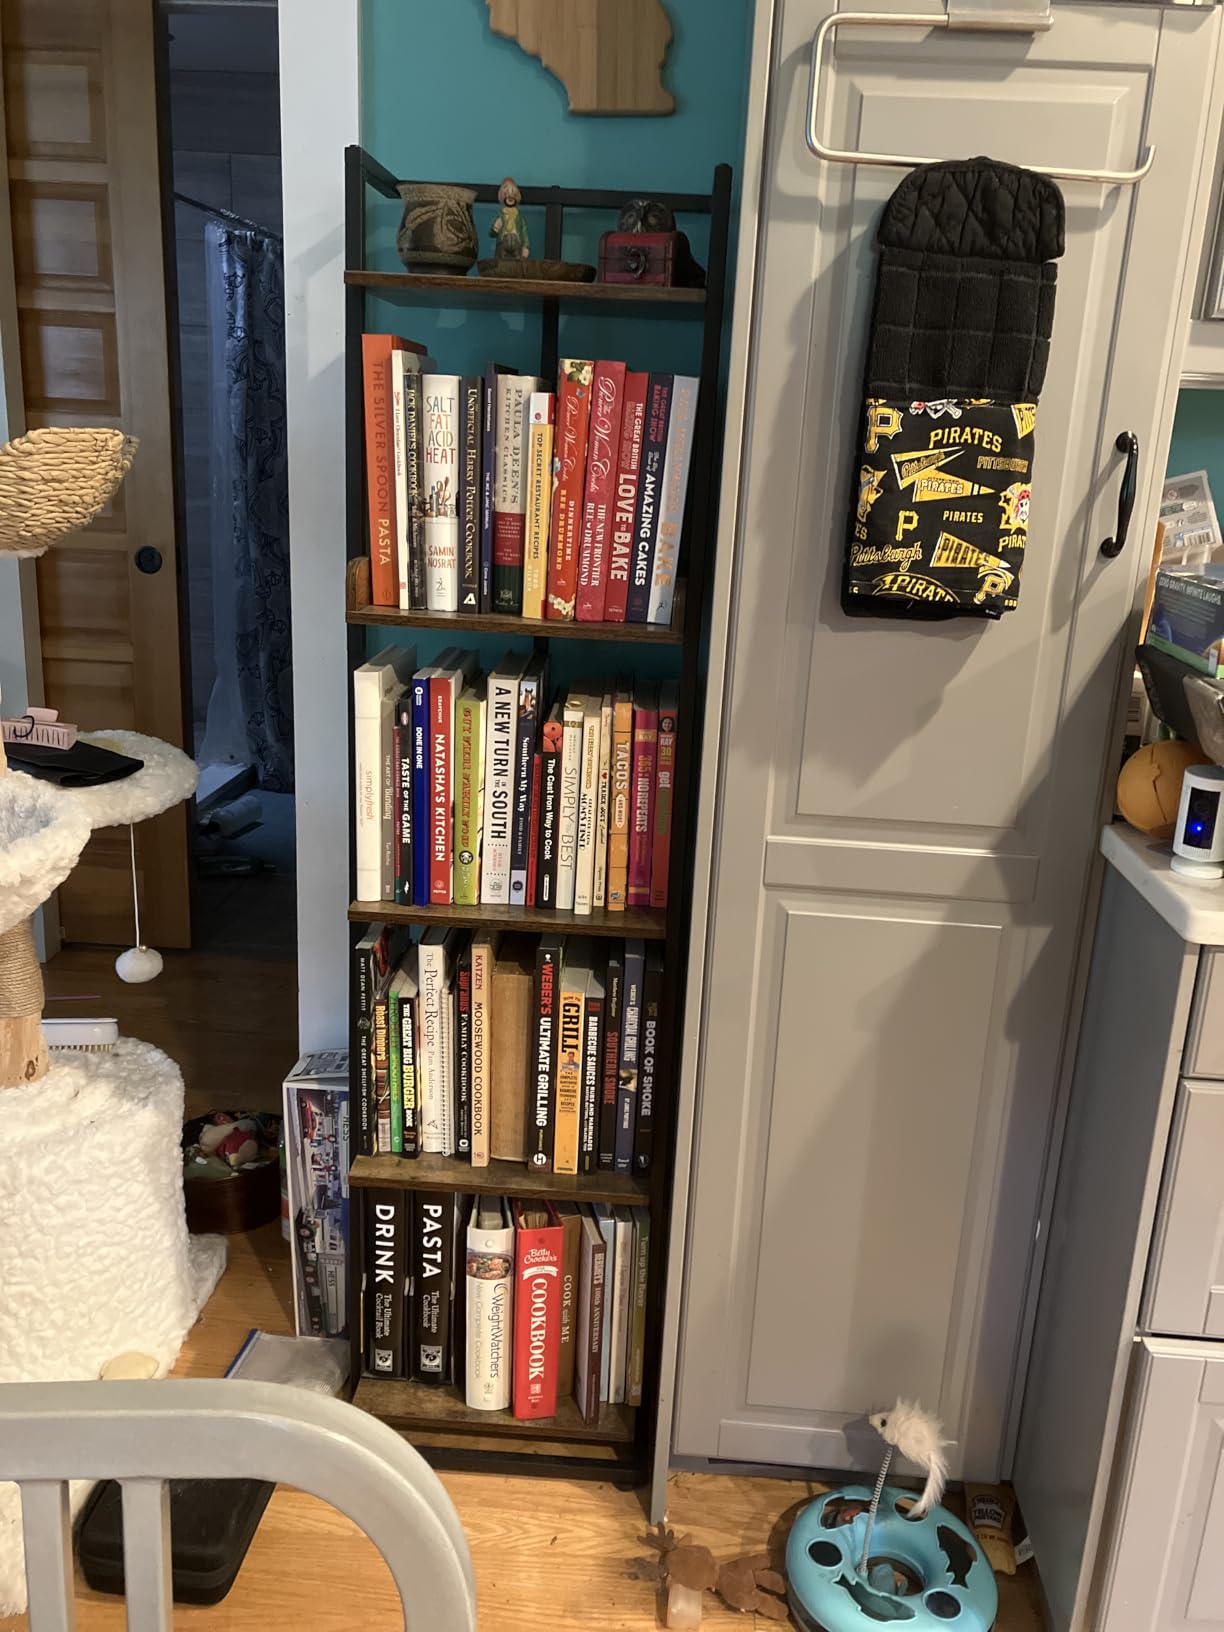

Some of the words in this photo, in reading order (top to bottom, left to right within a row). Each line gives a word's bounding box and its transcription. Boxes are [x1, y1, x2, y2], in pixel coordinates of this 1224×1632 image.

[371, 361, 385, 391] THE
[407, 389, 416, 409] JACK
[426, 396, 456, 413] SALT
[512, 388, 522, 439] PAULA
[635, 402, 644, 417] THE
[374, 397, 387, 449] SILVER
[430, 413, 451, 431] FAT
[466, 388, 478, 446] UNOFFICIAL
[503, 387, 512, 442] KITCHEN
[408, 411, 417, 449] DANIEL'S
[427, 430, 454, 447] ACID
[536, 432, 544, 447] TOP
[633, 418, 643, 442] GREAT
[928, 426, 1003, 453] PIRATES
[425, 447, 457, 465] HEAT
[465, 448, 477, 483] Harry
[535, 448, 543, 477] SECRET
[630, 443, 640, 470] BRITISH
[976, 455, 1028, 473] PITTSBURGH
[376, 454, 390, 513] SPOON
[408, 450, 418, 498] COOKBOOK
[502, 445, 510, 504] CLASSICS
[511, 446, 521, 504] DEEN'S
[919, 482, 964, 495] PIRATES
[465, 486, 477, 521] Potter
[534, 479, 542, 528] RESTAURANT
[559, 488, 567, 509] REE
[586, 502, 596, 522] REE
[597, 503, 606, 521] THE
[615, 473, 637, 524] LOVE
[640, 473, 657, 538] AMAZING
[565, 500, 576, 561] DINNERTIME
[596, 522, 605, 541] NEW
[895, 511, 919, 541] P
[942, 510, 984, 524] PIRATES
[378, 519, 391, 566] PASTA
[428, 545, 455, 557] SAMIN
[464, 523, 476, 579] COOKBOOK
[533, 531, 541, 560] RECIPES
[555, 512, 566, 571] DRUMMOND
[654, 521, 678, 587] BAKE
[850, 541, 923, 572] Pittsburgh
[938, 538, 991, 567] PIRATES
[428, 557, 456, 569] NOSRAT
[580, 529, 593, 585] DRUMMOND
[590, 543, 603, 587] FRONTIER
[610, 532, 632, 582] BAKE
[634, 541, 649, 587] CAKES
[495, 686, 512, 697] A
[493, 701, 511, 734] NEW
[415, 726, 423, 746] DONE
[415, 746, 423, 755] IN
[401, 757, 410, 787] TASTE
[415, 754, 423, 769] ONE
[434, 733, 446, 803] NATASHA'S
[493, 738, 510, 777] TURN
[520, 736, 530, 778] Southern
[547, 758, 556, 774] The
[615, 742, 630, 789] TACOS
[403, 789, 410, 799] OF
[518, 779, 528, 793] My
[546, 774, 555, 793] Cast
[658, 771, 672, 788] get
[517, 794, 527, 812] Way
[546, 794, 554, 810] Iron
[562, 767, 578, 823] SIMPLY
[401, 813, 411, 844] GAME
[490, 790, 508, 840] SOUTH
[544, 811, 554, 828] Way
[434, 807, 446, 862] KITCHEN
[545, 829, 552, 838] to
[544, 838, 553, 860] Cook
[559, 834, 574, 871] BEST
[426, 952, 434, 967] The
[475, 954, 483, 991] KATZEN
[424, 969, 439, 1007] Perfect
[458, 971, 470, 1012] Sopranos
[540, 963, 554, 1015] WEBER'S
[375, 1005, 387, 1028] Roast
[403, 1003, 411, 1017] THE
[624, 1006, 639, 1035] CHARCOAL
[402, 1017, 413, 1048] GREAT
[423, 1009, 439, 1047] Recipe
[460, 1013, 469, 1049] FAMILY
[474, 1001, 483, 1074] MOOSEWOOD
[561, 1002, 581, 1053] GRILL
[587, 1016, 598, 1056] BARBECUE
[645, 1020, 657, 1055] BOOK
[375, 1028, 386, 1061] Dinners
[402, 1047, 413, 1064] BIG
[427, 1050, 436, 1066] Pam
[538, 1016, 552, 1072] ULTIMATE
[604, 1031, 619, 1076] SOUTHERN
[460, 1050, 469, 1102] COOKBOOK
[585, 1056, 597, 1086] SAUCES
[643, 1056, 654, 1074] OF
[402, 1064, 415, 1109] BURGER
[427, 1068, 437, 1101] Anderson
[602, 1076, 616, 1104] SMOKE
[640, 1075, 653, 1117] SMOKE
[474, 1076, 483, 1136] COOKBOOK
[535, 1073, 549, 1127] GRILLING
[342, 1116, 350, 1142] HESS
[405, 1109, 413, 1127] BOOK
[375, 1204, 395, 1284] DRINK
[422, 1203, 443, 1279] PASTA
[529, 1248, 551, 1257] Betty
[640, 1235, 649, 1256] Turn
[593, 1252, 605, 1285] HERSHEY'S
[638, 1256, 647, 1268] up
[638, 1268, 647, 1283] the
[328, 1270, 336, 1290] HESS
[475, 1281, 484, 1298] New
[561, 1274, 573, 1308] COOK
[637, 1283, 646, 1307] flavor
[375, 1292, 384, 1321] Cocktail
[384, 1294, 393, 1308] The
[422, 1294, 431, 1329] Cookbook
[431, 1290, 440, 1305] The
[375, 1321, 384, 1340] Book
[383, 1307, 393, 1337] Ultimate
[430, 1304, 440, 1334] Ultimate
[473, 1301, 483, 1339] Complete
[528, 1278, 548, 1381] COOKBOOK
[561, 1309, 570, 1324] with
[591, 1306, 602, 1354] ANNIVERSARY
[560, 1325, 570, 1344] ME
[473, 1340, 483, 1379] Cookbook
